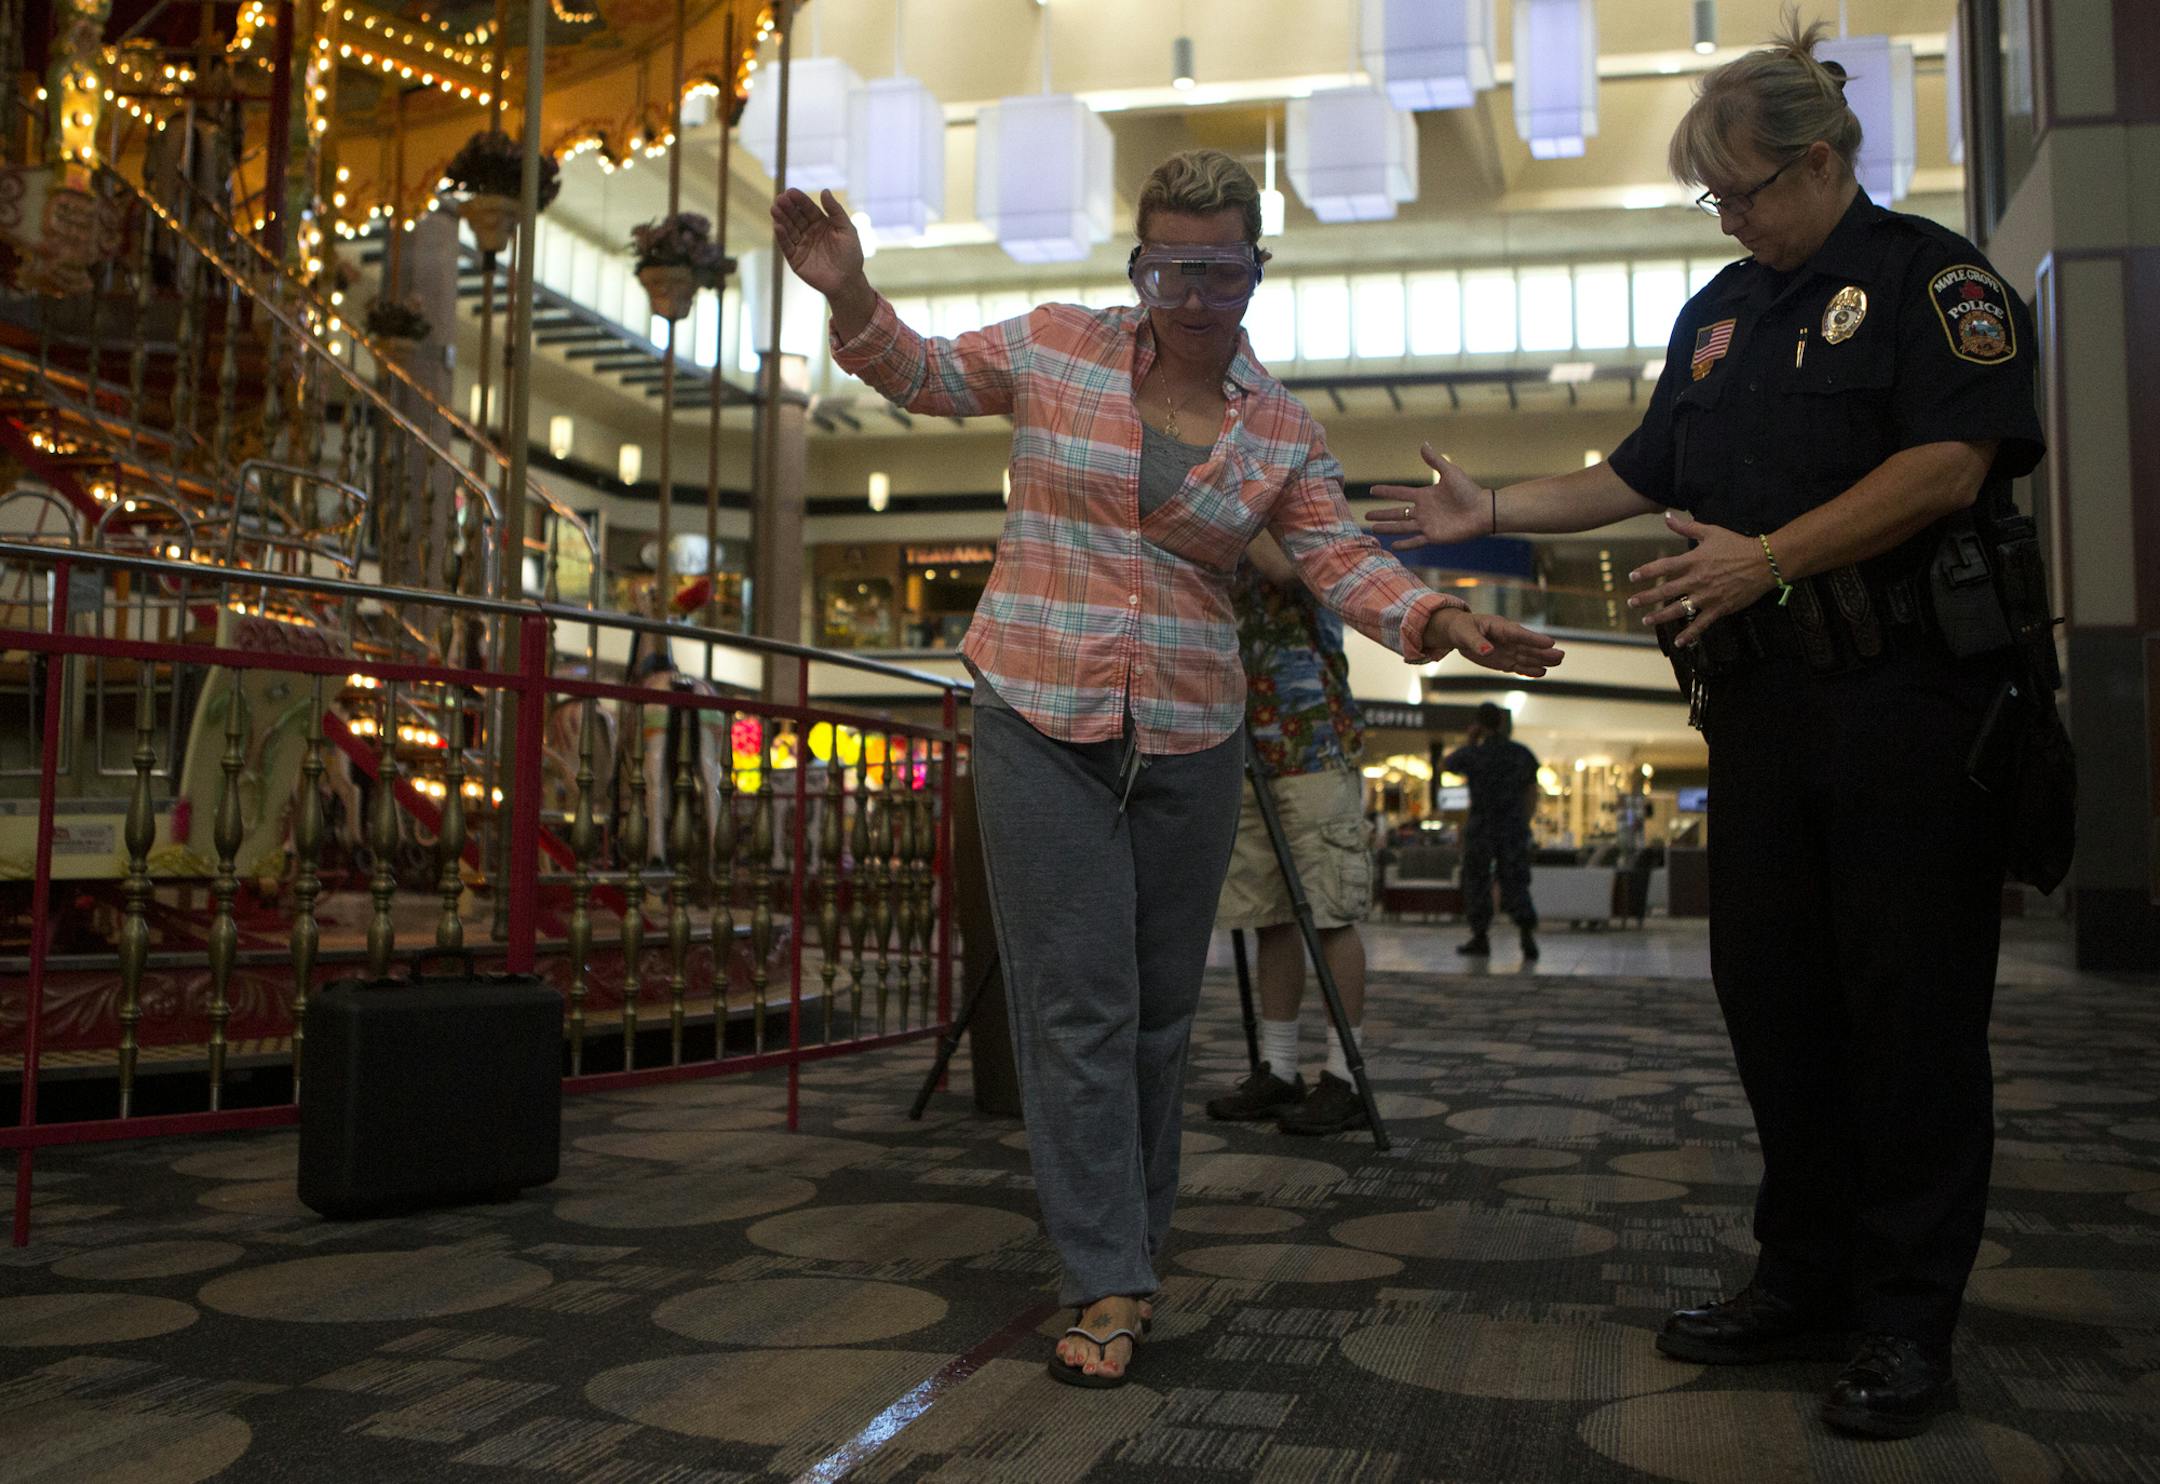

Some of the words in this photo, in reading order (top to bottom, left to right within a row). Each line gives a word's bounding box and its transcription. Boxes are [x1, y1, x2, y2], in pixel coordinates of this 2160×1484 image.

[1933, 269, 1967, 293] MAPLE
[1967, 269, 2000, 293] GROVE
[1948, 300, 2004, 320] POLICE
[1365, 708, 1424, 727] COFFEE
